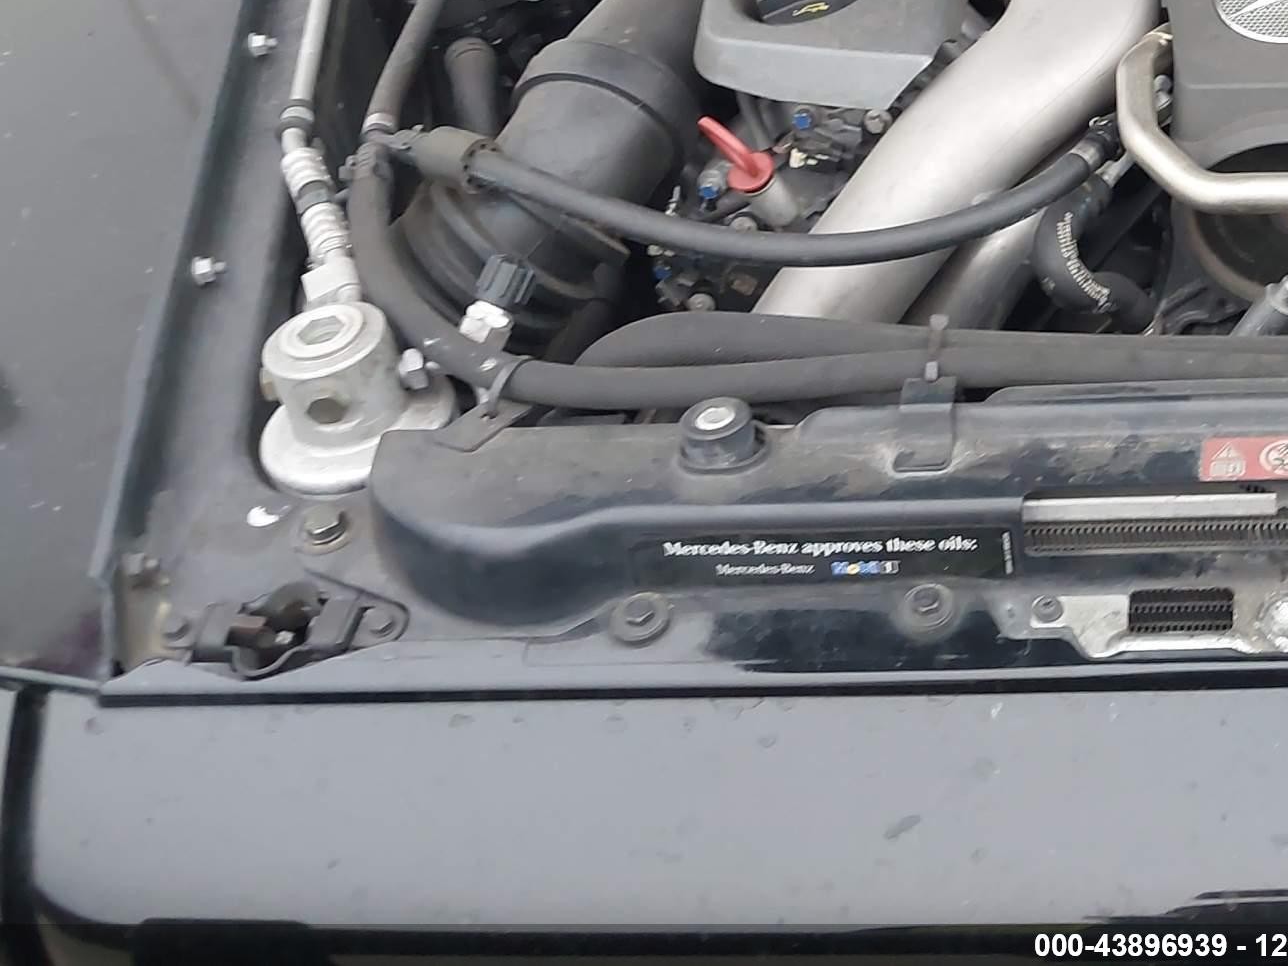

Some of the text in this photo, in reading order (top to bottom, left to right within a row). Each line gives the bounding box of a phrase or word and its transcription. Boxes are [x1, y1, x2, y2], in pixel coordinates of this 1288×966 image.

[663, 535, 978, 557] Mercedes-Benz approves these oils:
